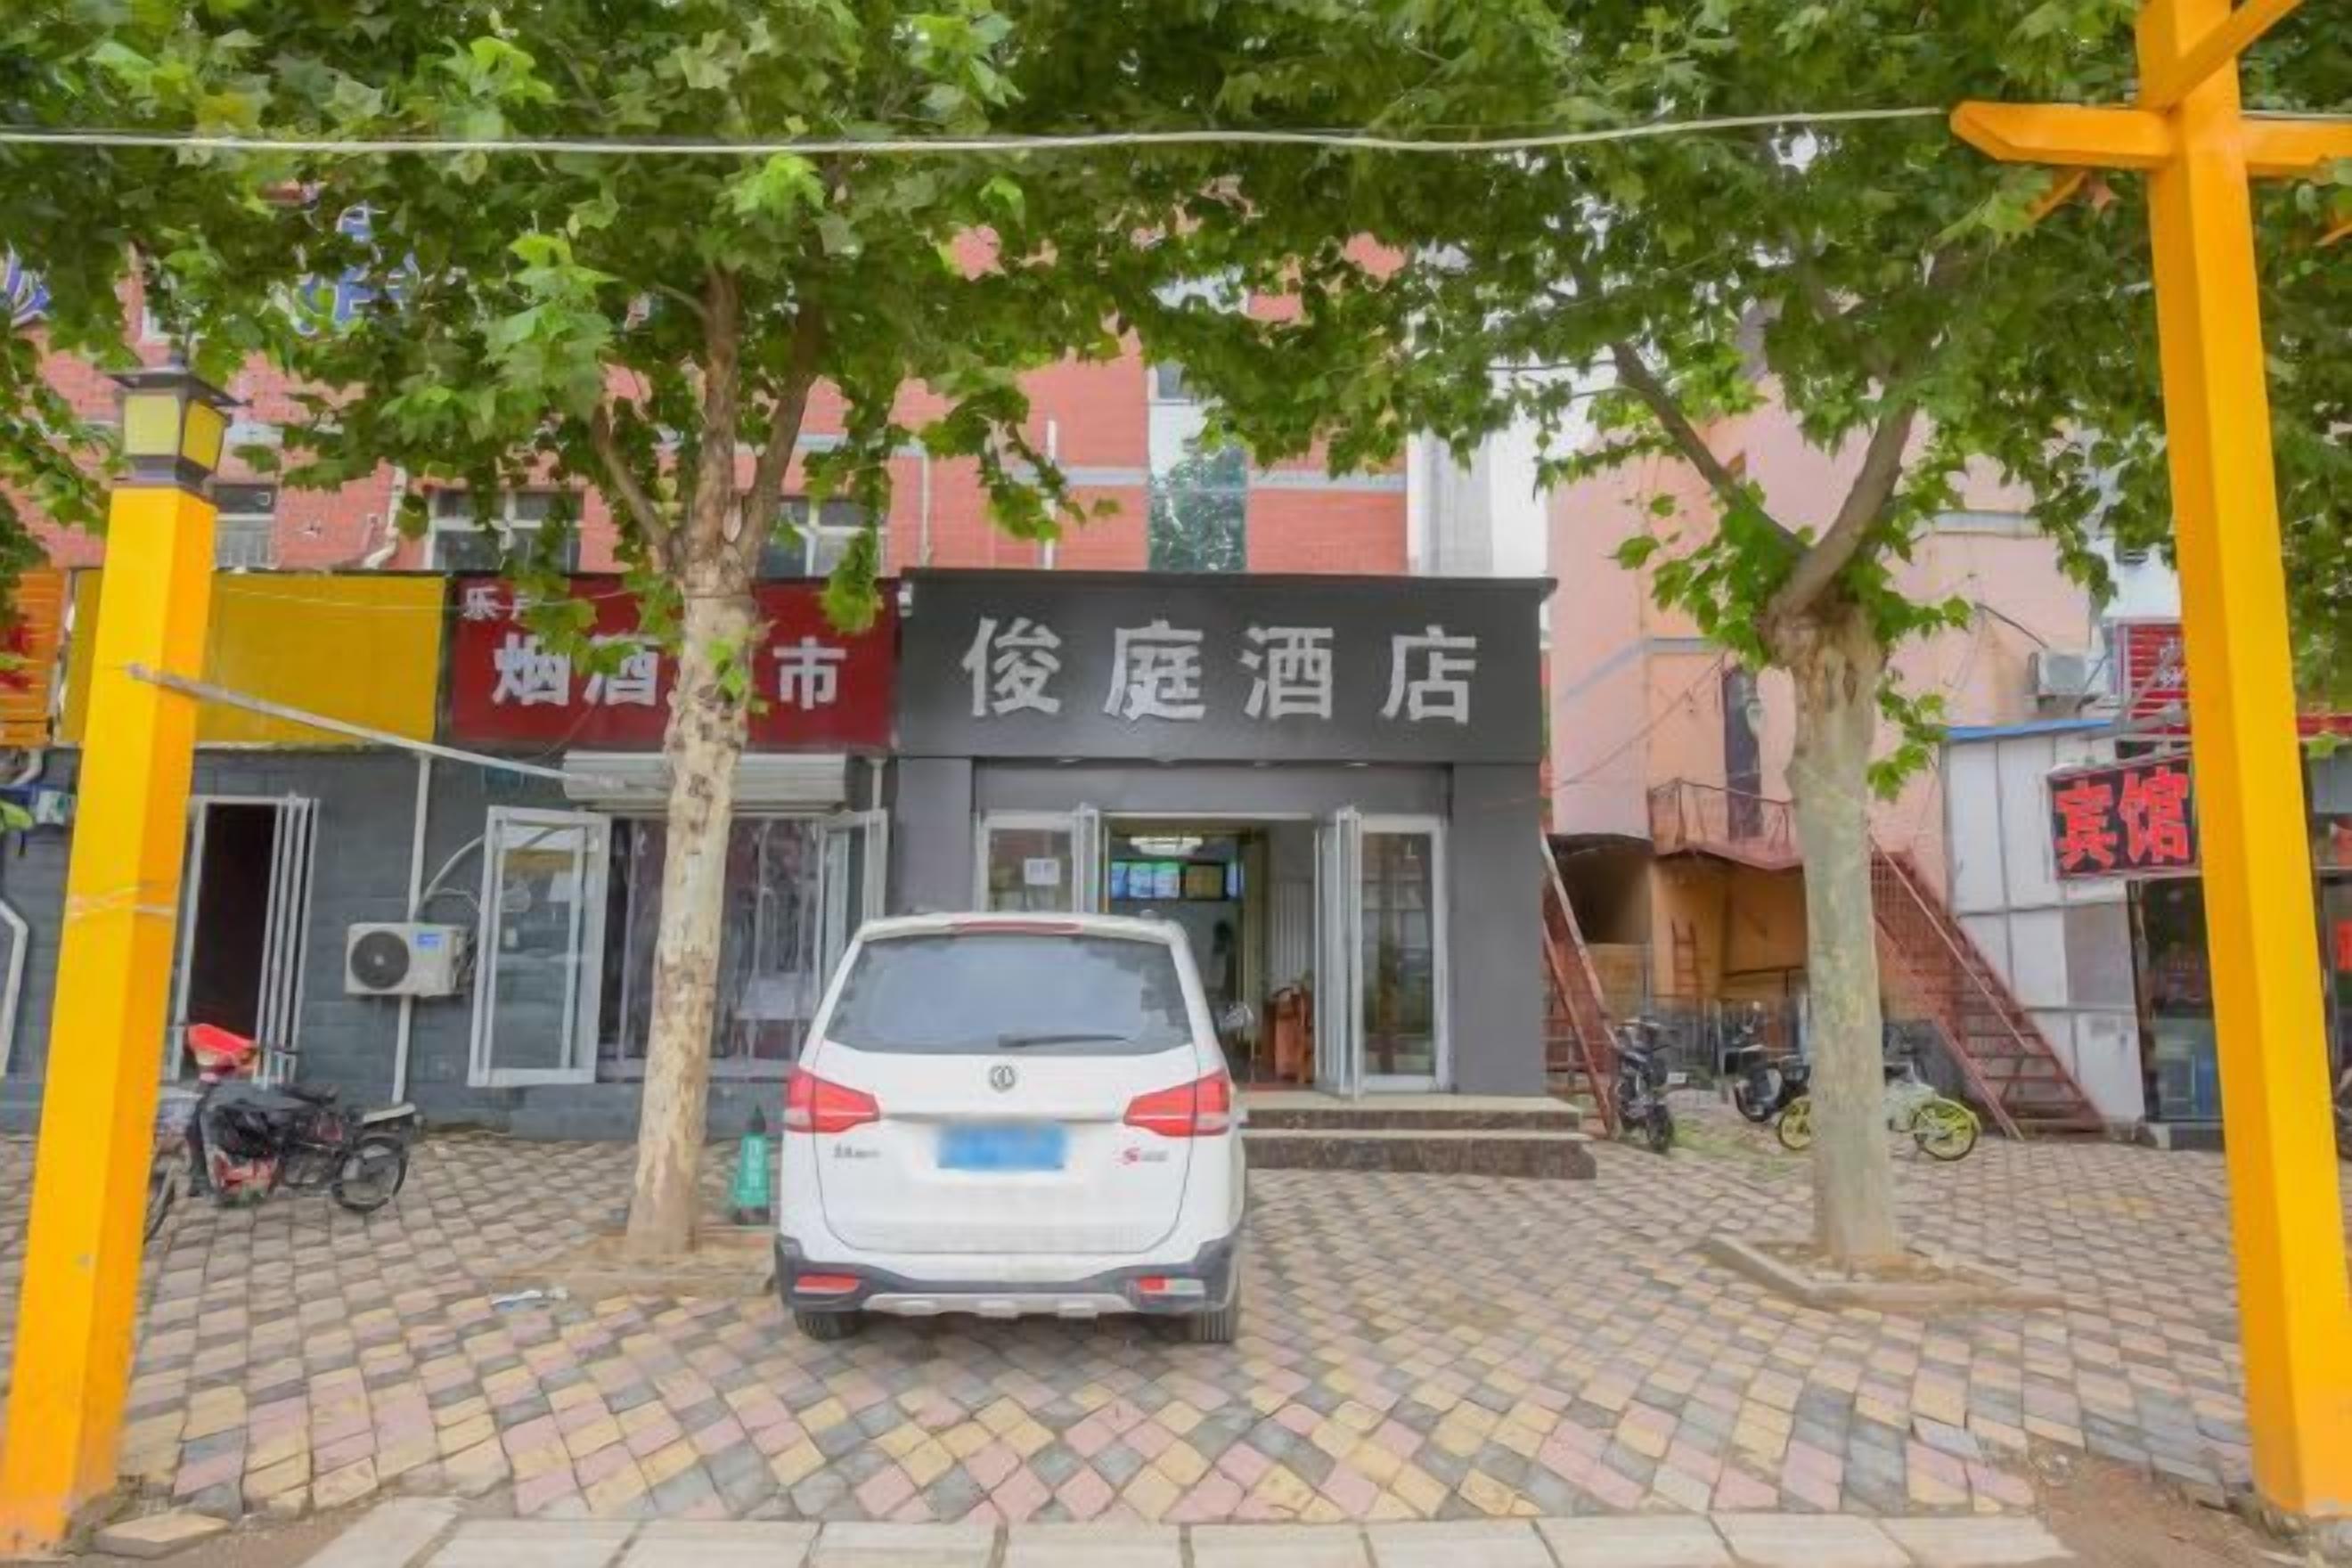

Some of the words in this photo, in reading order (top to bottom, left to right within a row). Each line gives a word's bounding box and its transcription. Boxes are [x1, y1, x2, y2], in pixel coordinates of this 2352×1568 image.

[493, 633, 846, 710] 烟酒市
[962, 617, 1476, 723] 俊庭酒店
[2055, 767, 2188, 870] 宾馆
